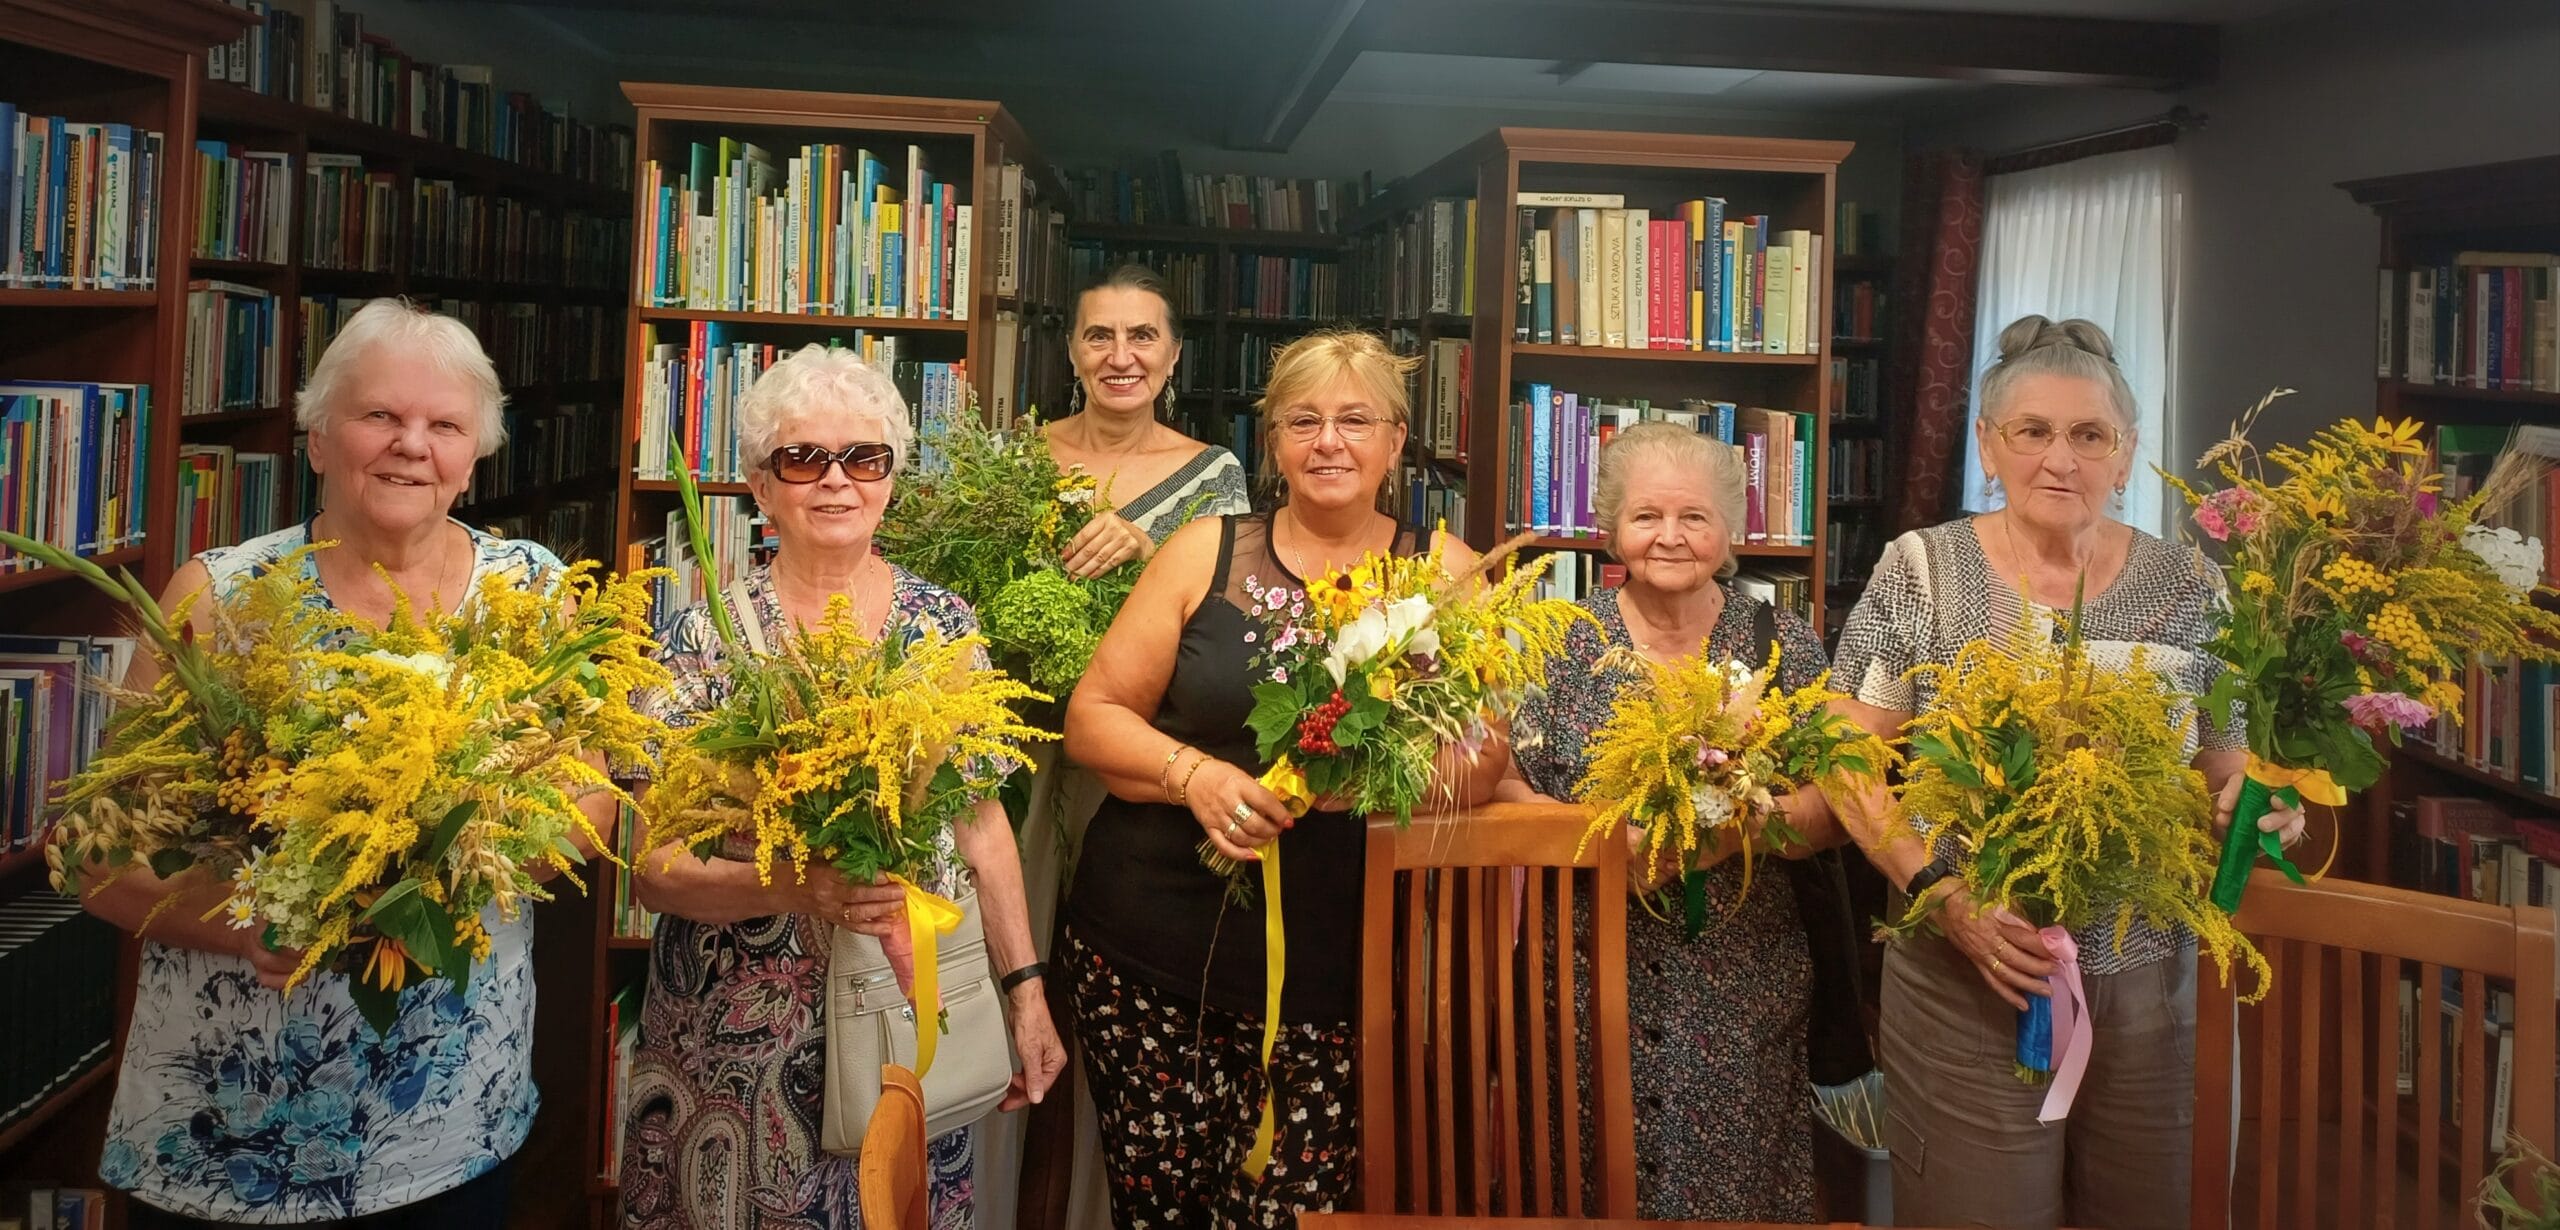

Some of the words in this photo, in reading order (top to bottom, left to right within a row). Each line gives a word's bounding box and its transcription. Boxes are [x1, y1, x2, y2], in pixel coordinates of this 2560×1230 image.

[66, 202, 77, 228] 100
[1711, 206, 1723, 237] SZTUKA
[1610, 236, 1621, 284] KRAKOWA
[1634, 235, 1643, 265] POLSKA
[1653, 247, 1661, 269] POLSKI
[1711, 237, 1721, 274] LUDOWA
[1653, 269, 1661, 292] STREET
[1672, 252, 1681, 279] POLSKI
[1634, 266, 1643, 297] SZTUKA
[1672, 279, 1681, 308] STREET
[1610, 286, 1621, 321] SZTUKA
[1653, 293, 1661, 305] ART
[1711, 282, 1720, 315] POLSCE
[1672, 309, 1681, 326] ART
[1749, 447, 1761, 488] DOMY
[1792, 448, 1803, 507] Architektura
